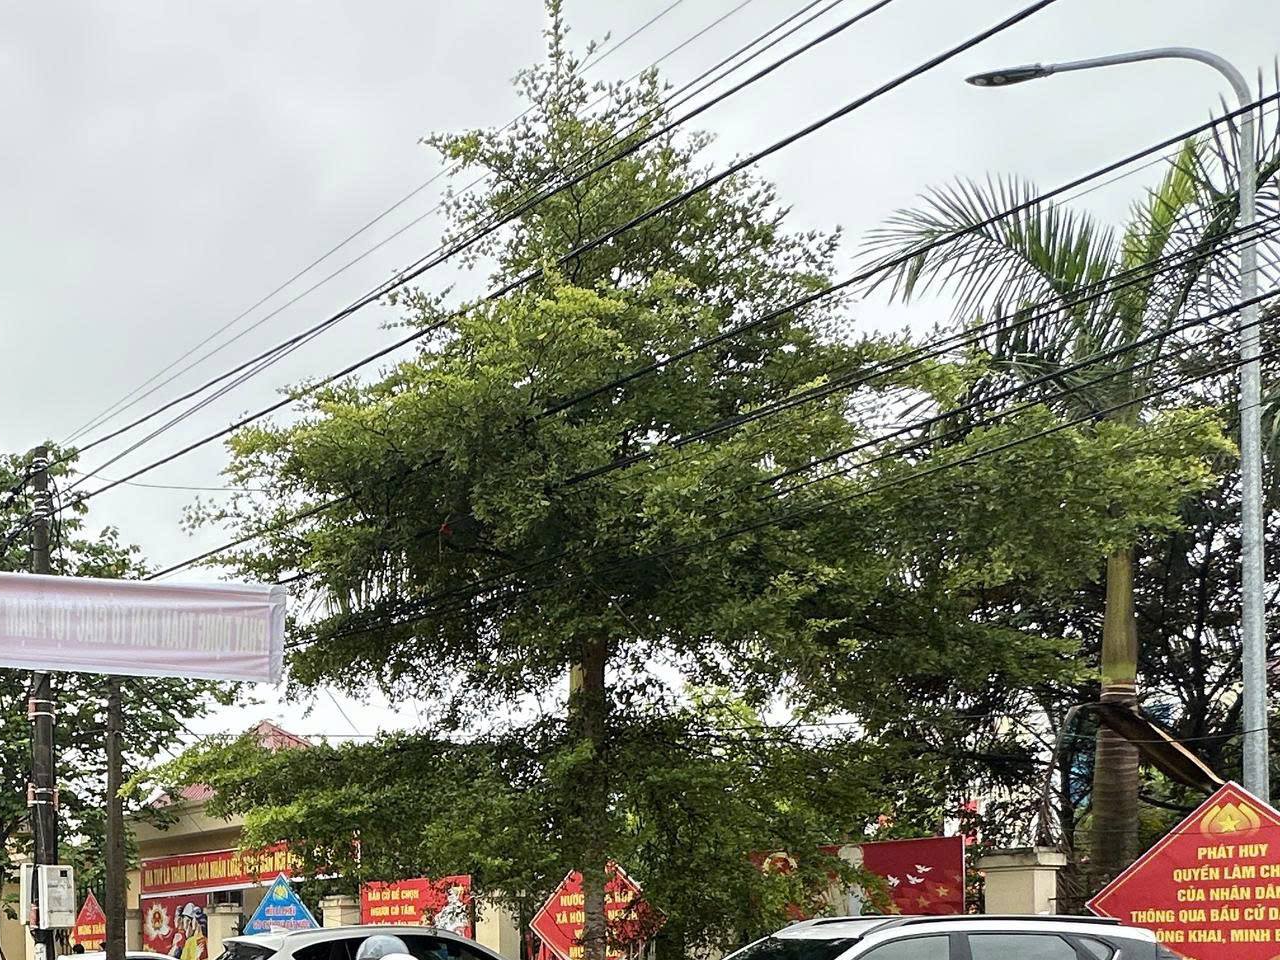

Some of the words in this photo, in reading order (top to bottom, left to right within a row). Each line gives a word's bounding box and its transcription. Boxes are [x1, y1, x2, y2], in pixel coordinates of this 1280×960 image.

[1197, 843, 1235, 860] PHÁT
[1238, 843, 1269, 858] HUY
[1223, 864, 1256, 880] LÀM
[1259, 864, 1280, 879] CH
[1177, 885, 1206, 902] CỦA
[1209, 885, 1251, 901] NHÂN
[1130, 908, 1175, 924] THÔNG
[1178, 909, 1207, 924] QUA
[1155, 928, 1185, 943] ÔNG
[1188, 929, 1226, 944] KHAI,
[1230, 929, 1271, 942] MINH
